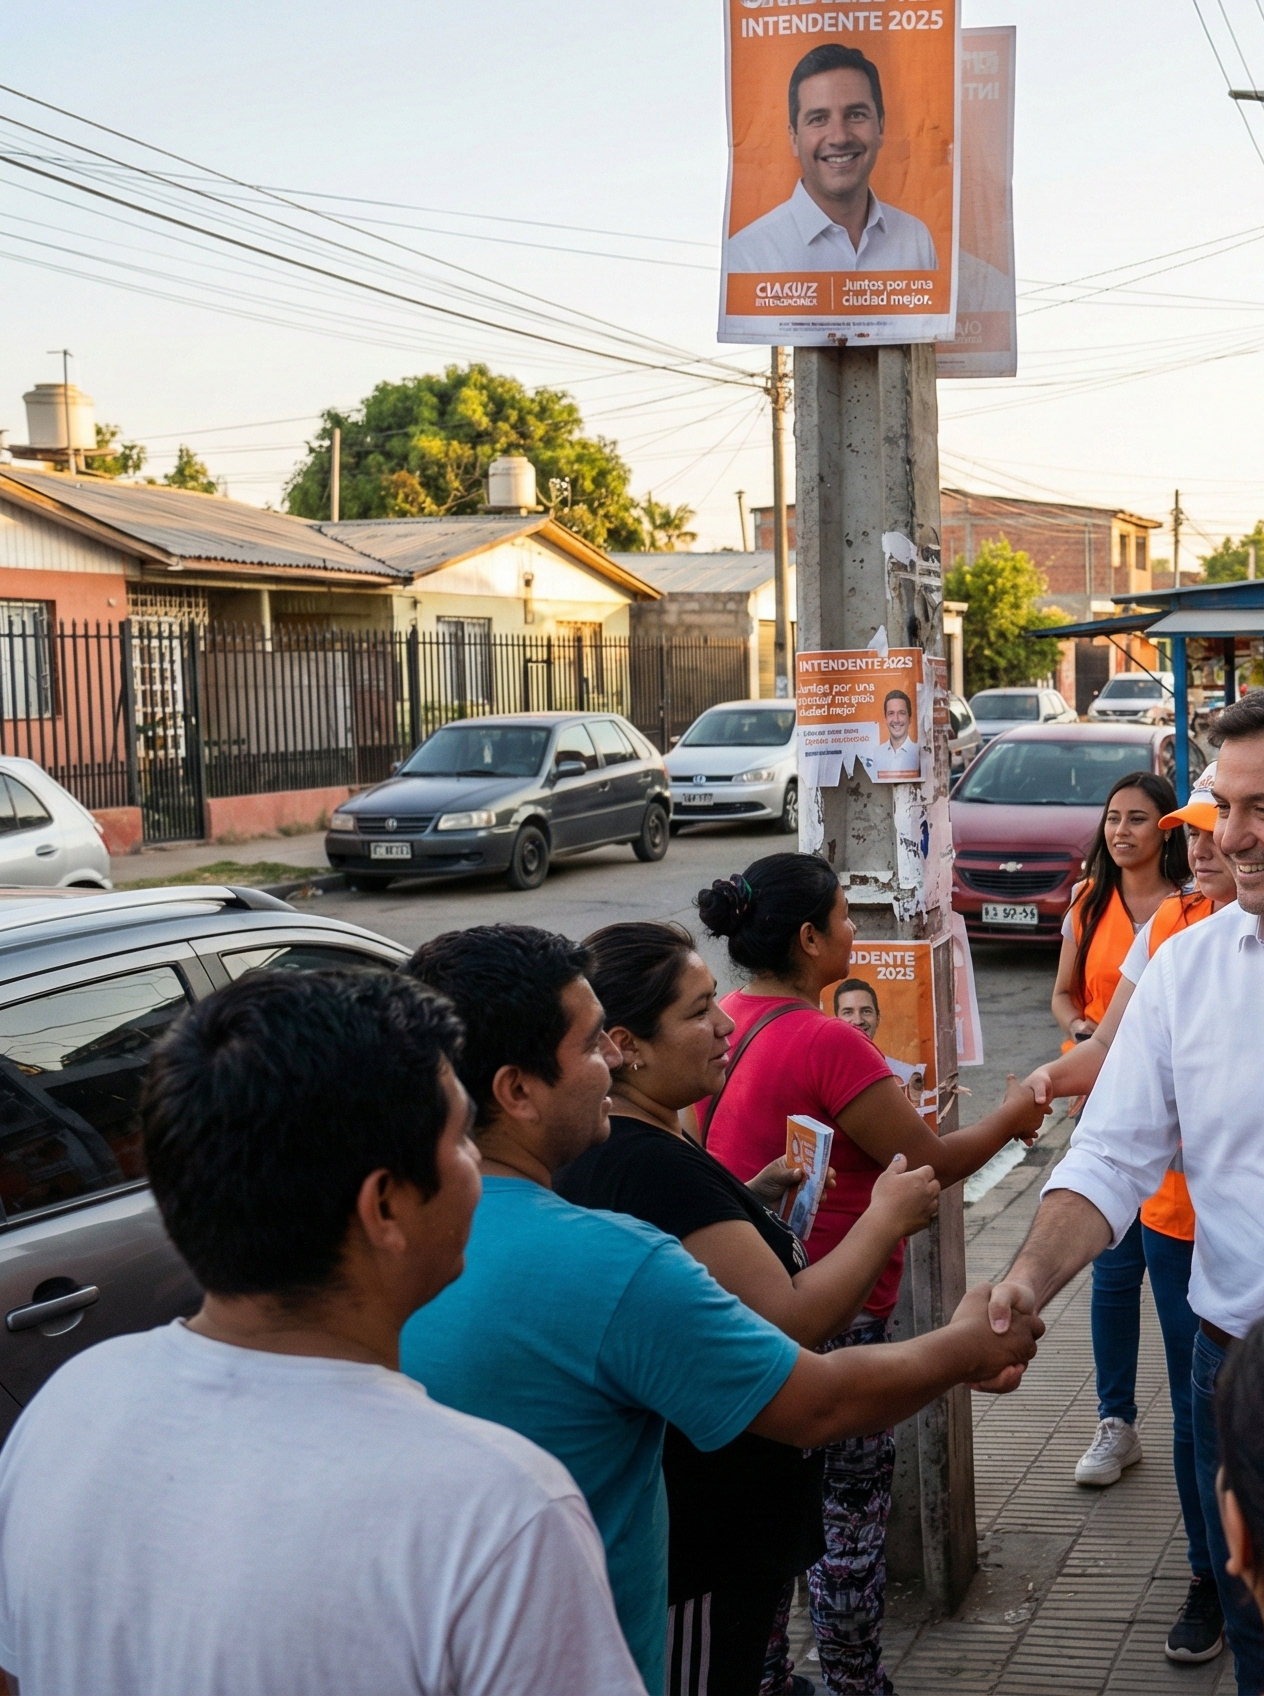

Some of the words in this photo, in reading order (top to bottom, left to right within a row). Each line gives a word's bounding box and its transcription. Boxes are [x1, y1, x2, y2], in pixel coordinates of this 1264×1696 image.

[741, 11, 883, 38] INTENDENTE
[888, 9, 944, 31] 2025
[886, 280, 908, 293] por
[910, 279, 933, 290] una
[842, 291, 887, 306] ciudad
[890, 293, 933, 309] mejor.
[799, 657, 882, 673] INTENDENTE
[877, 966, 915, 980] 2025
